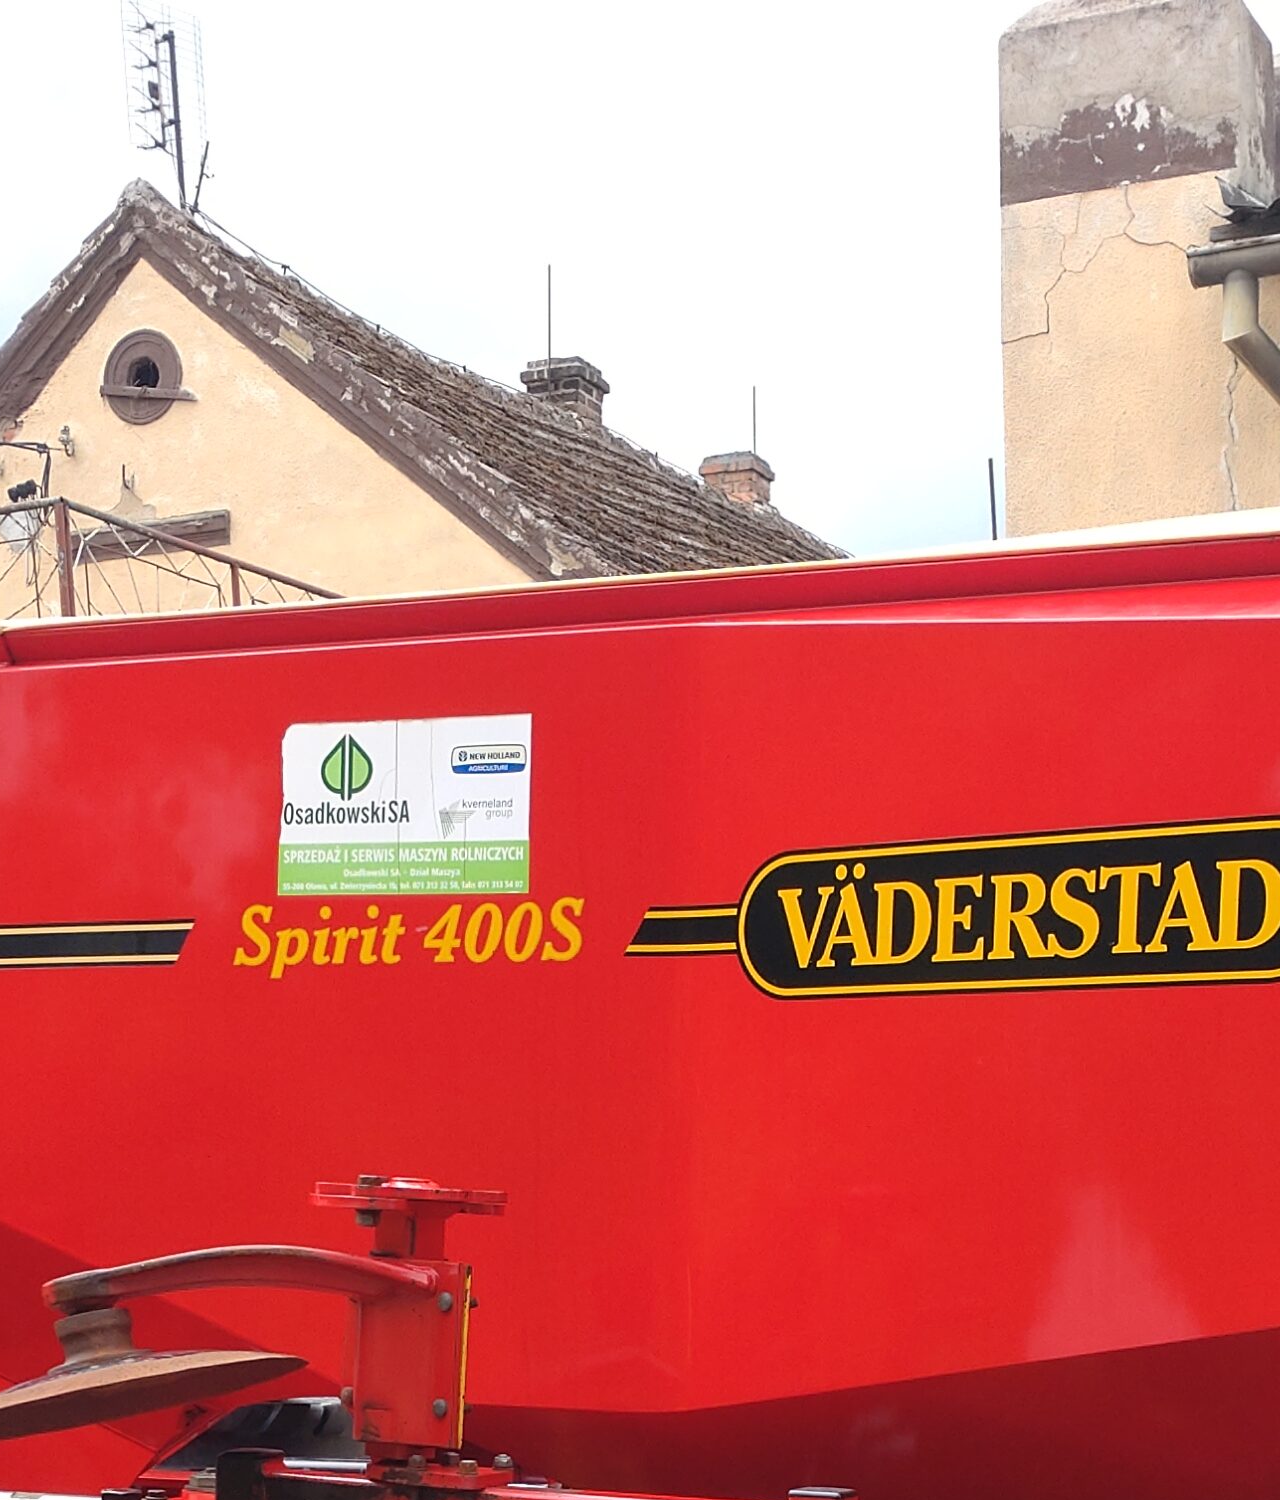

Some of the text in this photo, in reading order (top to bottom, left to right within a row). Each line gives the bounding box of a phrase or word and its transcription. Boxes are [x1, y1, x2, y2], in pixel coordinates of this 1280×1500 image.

[469, 751, 521, 760] NEW HOLLAND
[462, 797, 513, 809] kverneland
[485, 809, 513, 820] group
[283, 845, 341, 864] SPRZEDAŻ
[351, 848, 395, 863] SERWIS
[399, 847, 448, 862] MASZYN
[451, 846, 524, 861] ROLNICZYCH
[233, 896, 585, 979] Spirit 400S
